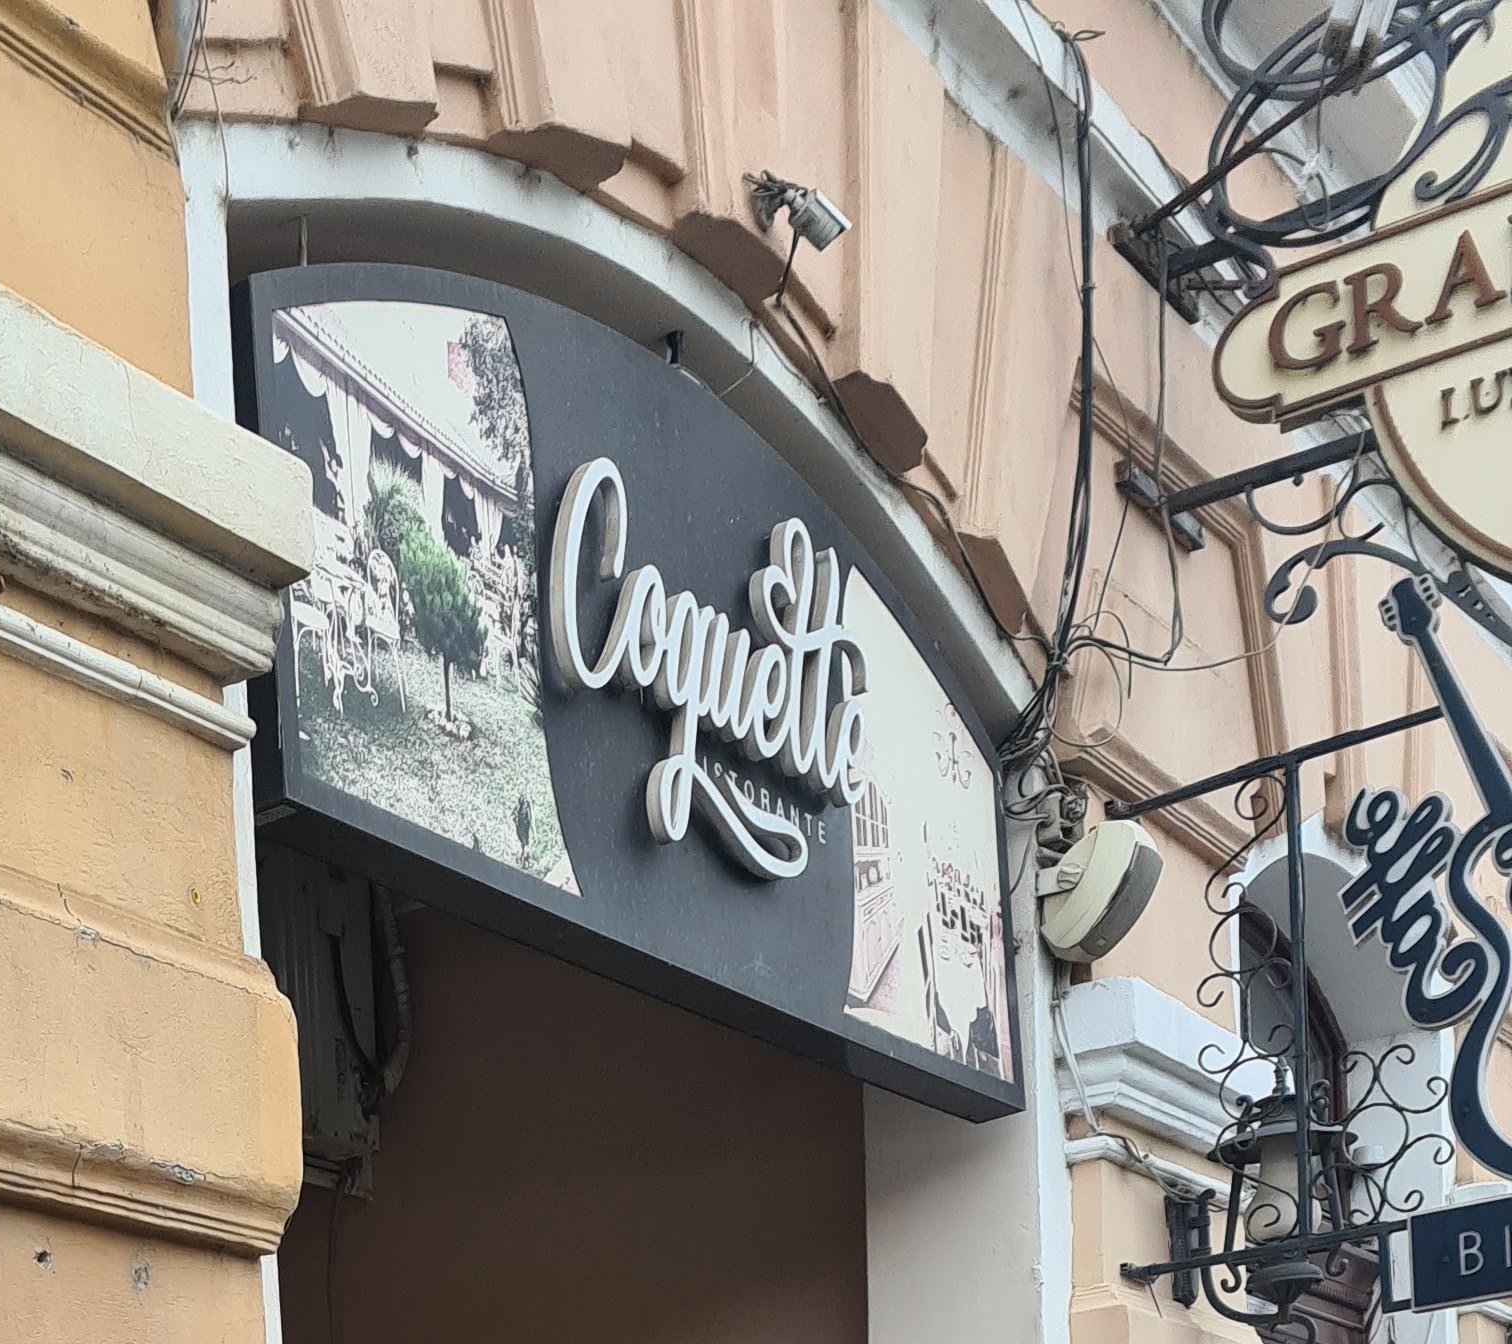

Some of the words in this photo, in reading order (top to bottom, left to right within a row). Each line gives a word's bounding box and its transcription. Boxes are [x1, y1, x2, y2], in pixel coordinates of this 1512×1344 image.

[1267, 214, 1512, 371] GRA
[1440, 366, 1512, 431] LU
[550, 456, 871, 880] Coquette
[702, 755, 827, 845] ISTORANTE
